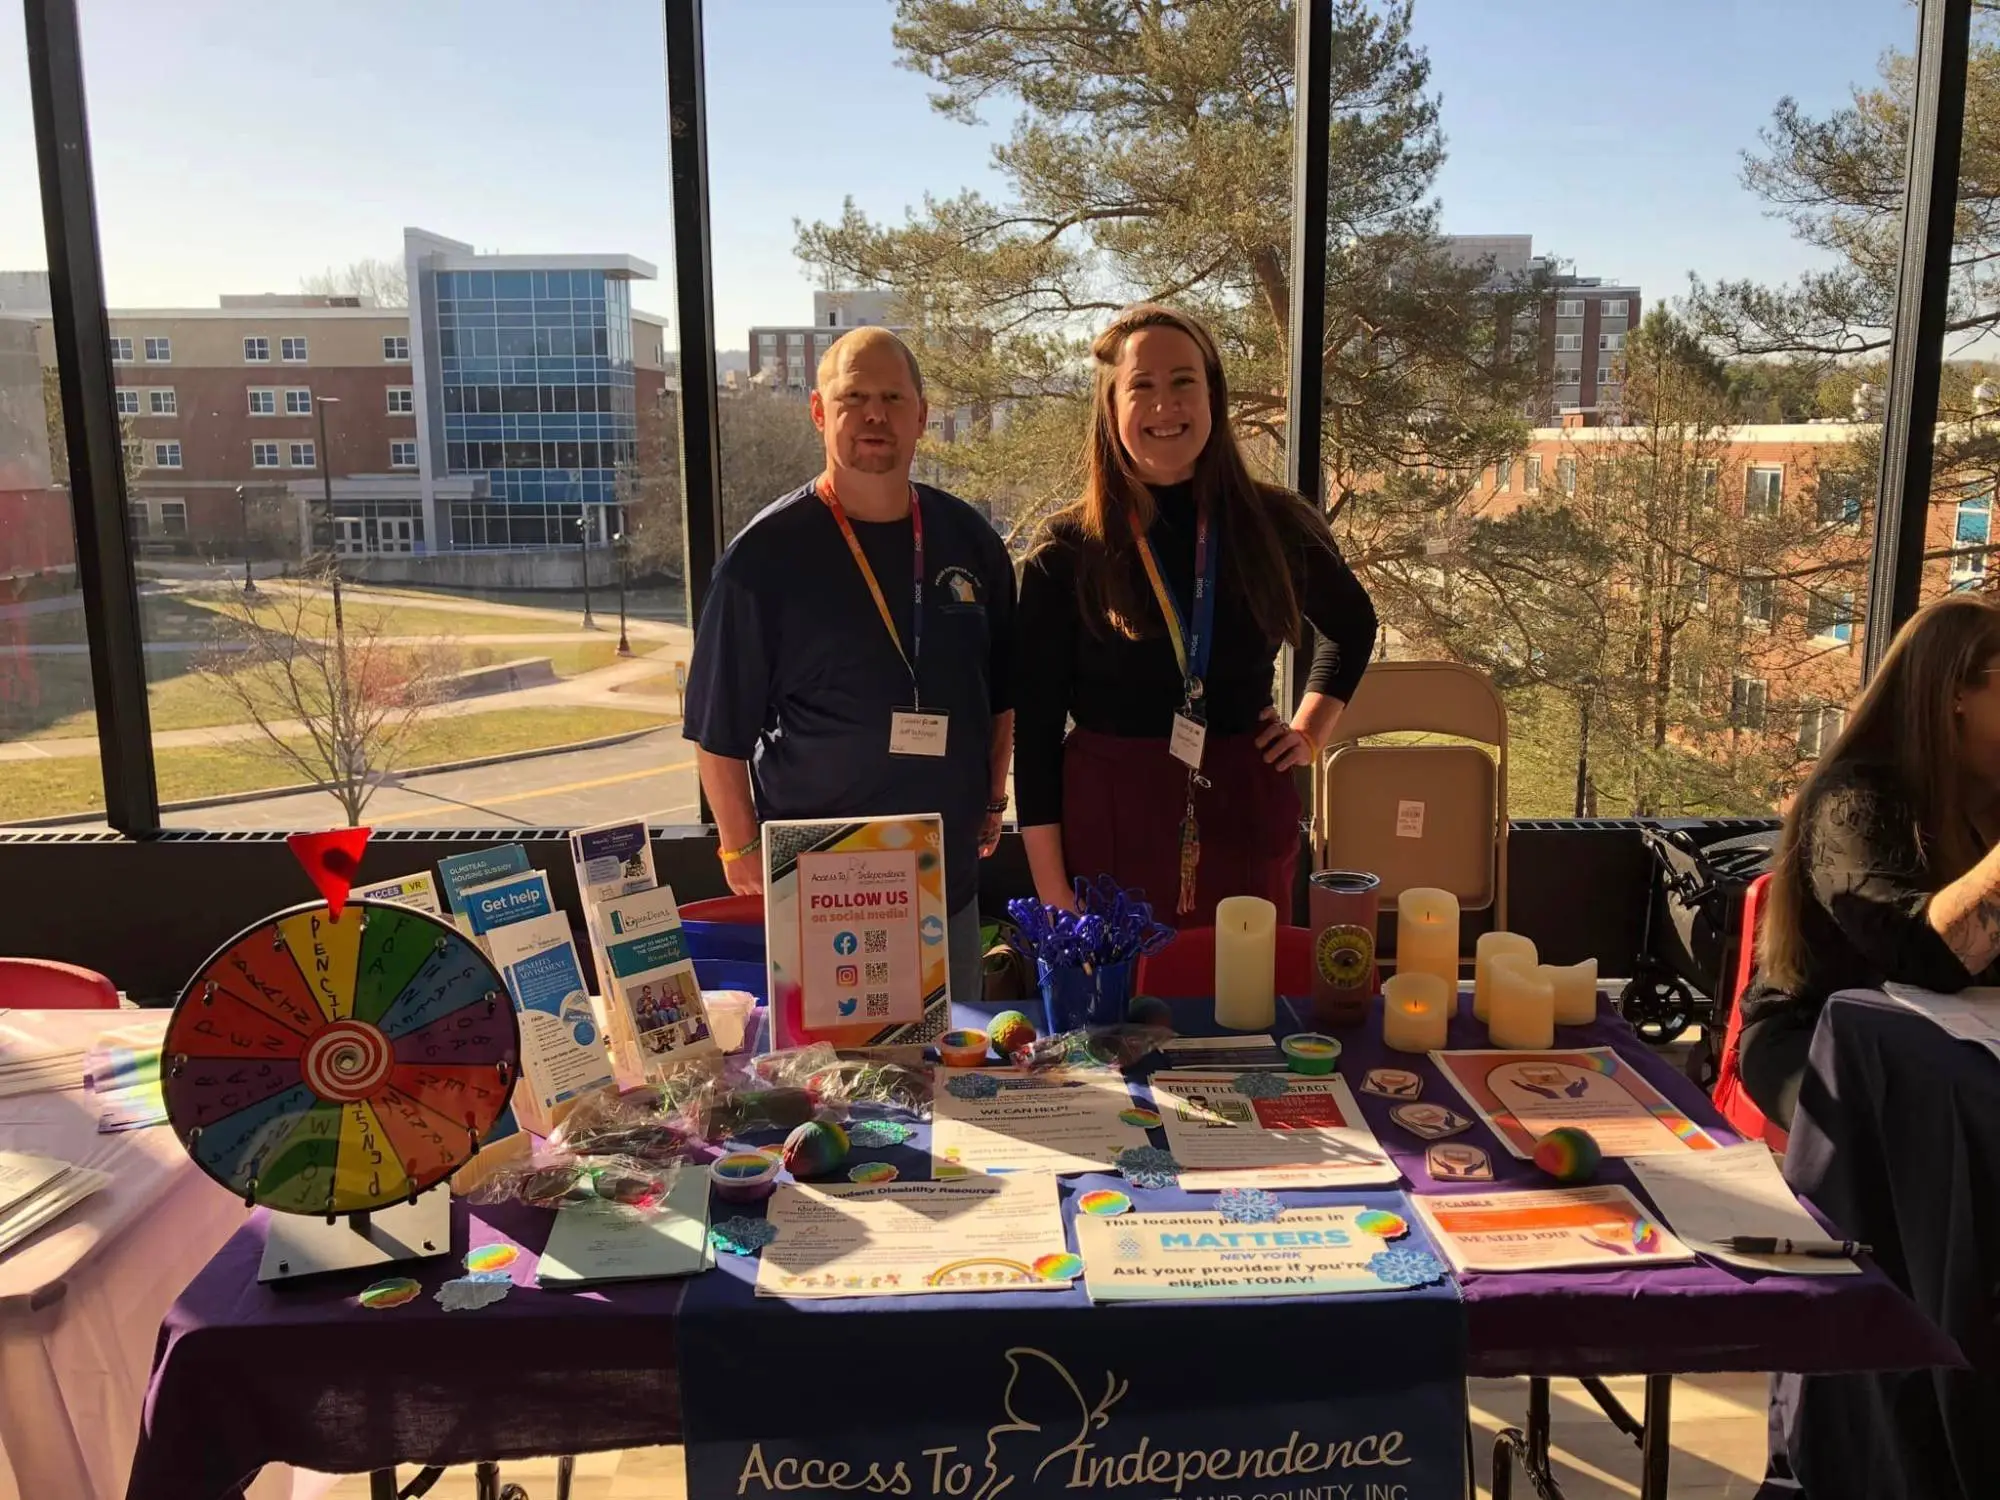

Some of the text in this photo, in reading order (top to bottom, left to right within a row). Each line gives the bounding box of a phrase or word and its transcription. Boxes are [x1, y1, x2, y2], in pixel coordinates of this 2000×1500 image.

[408, 881, 423, 890] VR
[482, 897, 508, 913] Get
[509, 888, 541, 906] help
[810, 890, 909, 909] FOLLOW US
[811, 908, 909, 924] on social media!
[194, 1018, 286, 1052] PEN
[1168, 1085, 1200, 1094] FREE
[980, 1105, 1069, 1116] WE CAN HELP!
[877, 1185, 936, 1195] Disability
[1104, 1219, 1140, 1227] This
[1142, 1217, 1214, 1226] location
[1329, 1213, 1345, 1221] in
[1159, 1229, 1351, 1248] MATTERS
[1457, 1235, 1484, 1244] WE
[1487, 1233, 1529, 1243] NEED
[1219, 1251, 1303, 1261] NEW YORK
[1113, 1266, 1148, 1276] Ask
[1151, 1266, 1199, 1277] your
[1200, 1264, 1284, 1276] provider
[1286, 1263, 1302, 1272] if
[1168, 1275, 1316, 1288] eligible TODAY!
[736, 1430, 1412, 1496] Access To Independence
